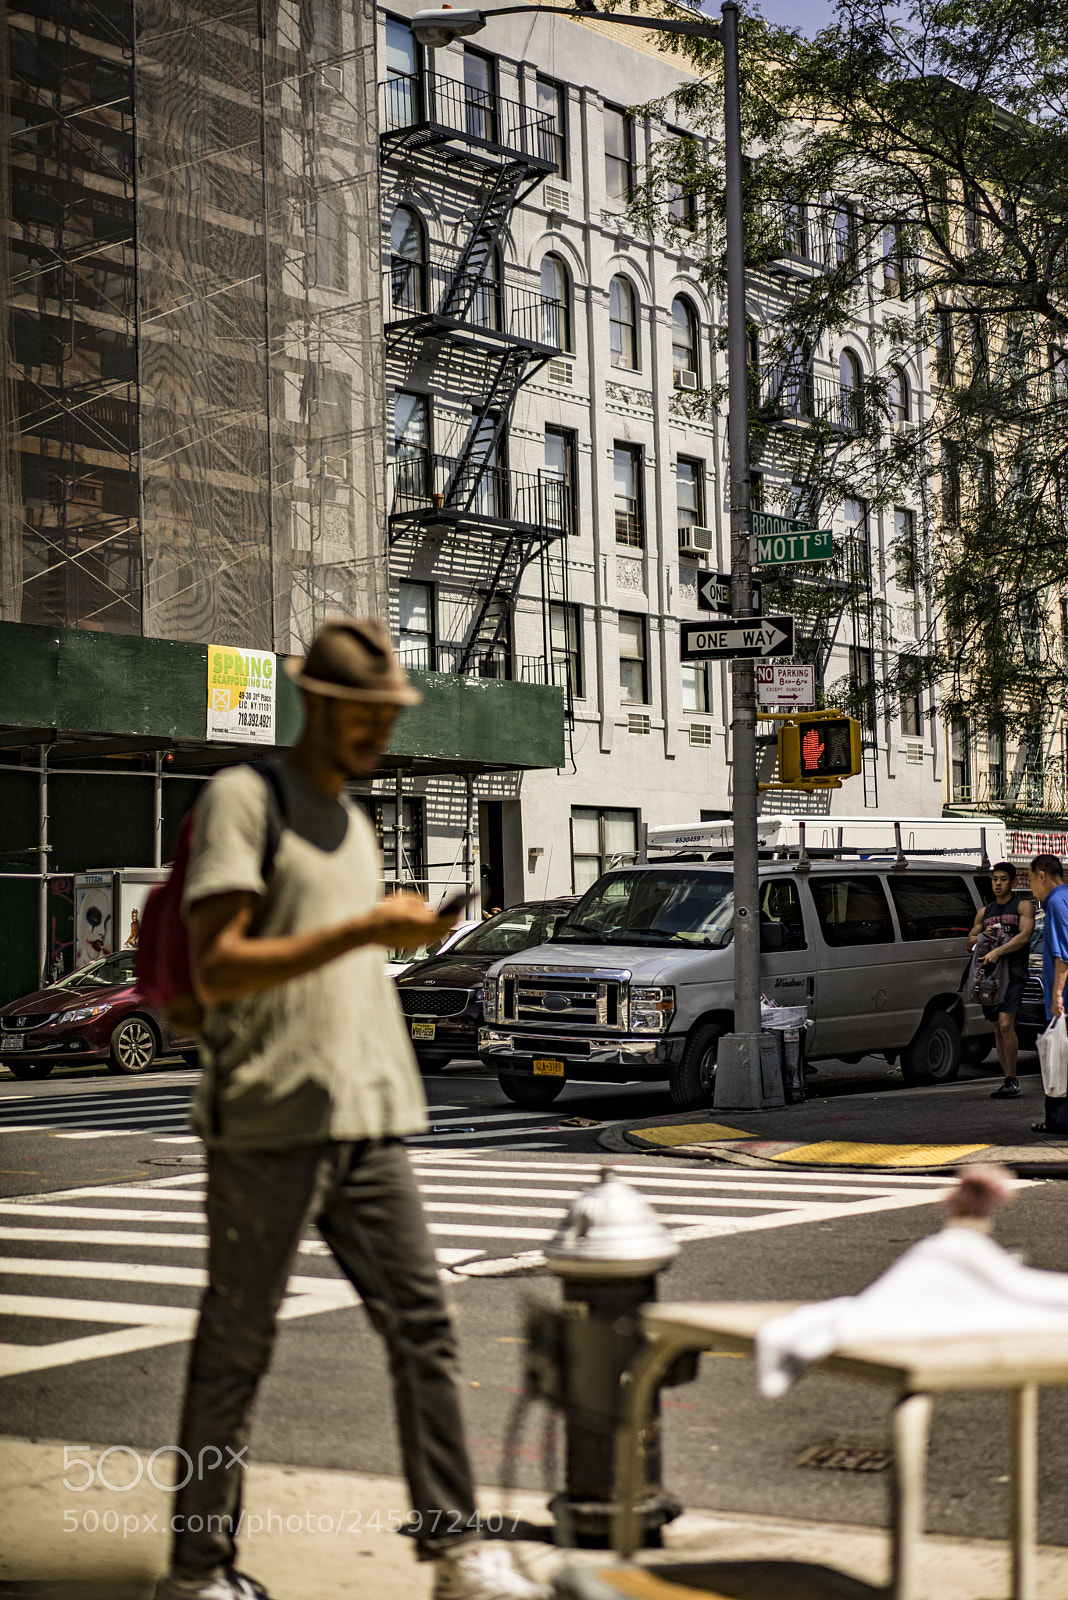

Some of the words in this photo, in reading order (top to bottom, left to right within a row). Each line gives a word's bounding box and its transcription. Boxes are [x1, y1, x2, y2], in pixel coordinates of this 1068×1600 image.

[752, 514, 793, 535] BROOME
[797, 524, 806, 532] ST
[757, 535, 811, 562] MOTT
[814, 533, 829, 546] ST
[709, 584, 728, 602] ONE
[696, 632, 728, 649] ONE
[742, 629, 776, 647] WAY
[214, 653, 272, 679] SPRING
[758, 667, 773, 681] NO
[777, 669, 809, 678] PARKING
[213, 674, 260, 688] SCAFFOLDING
[262, 679, 272, 690] LLC
[250, 701, 257, 711] NY
[675, 835, 701, 843] 6530459
[774, 977, 806, 989] Windows
